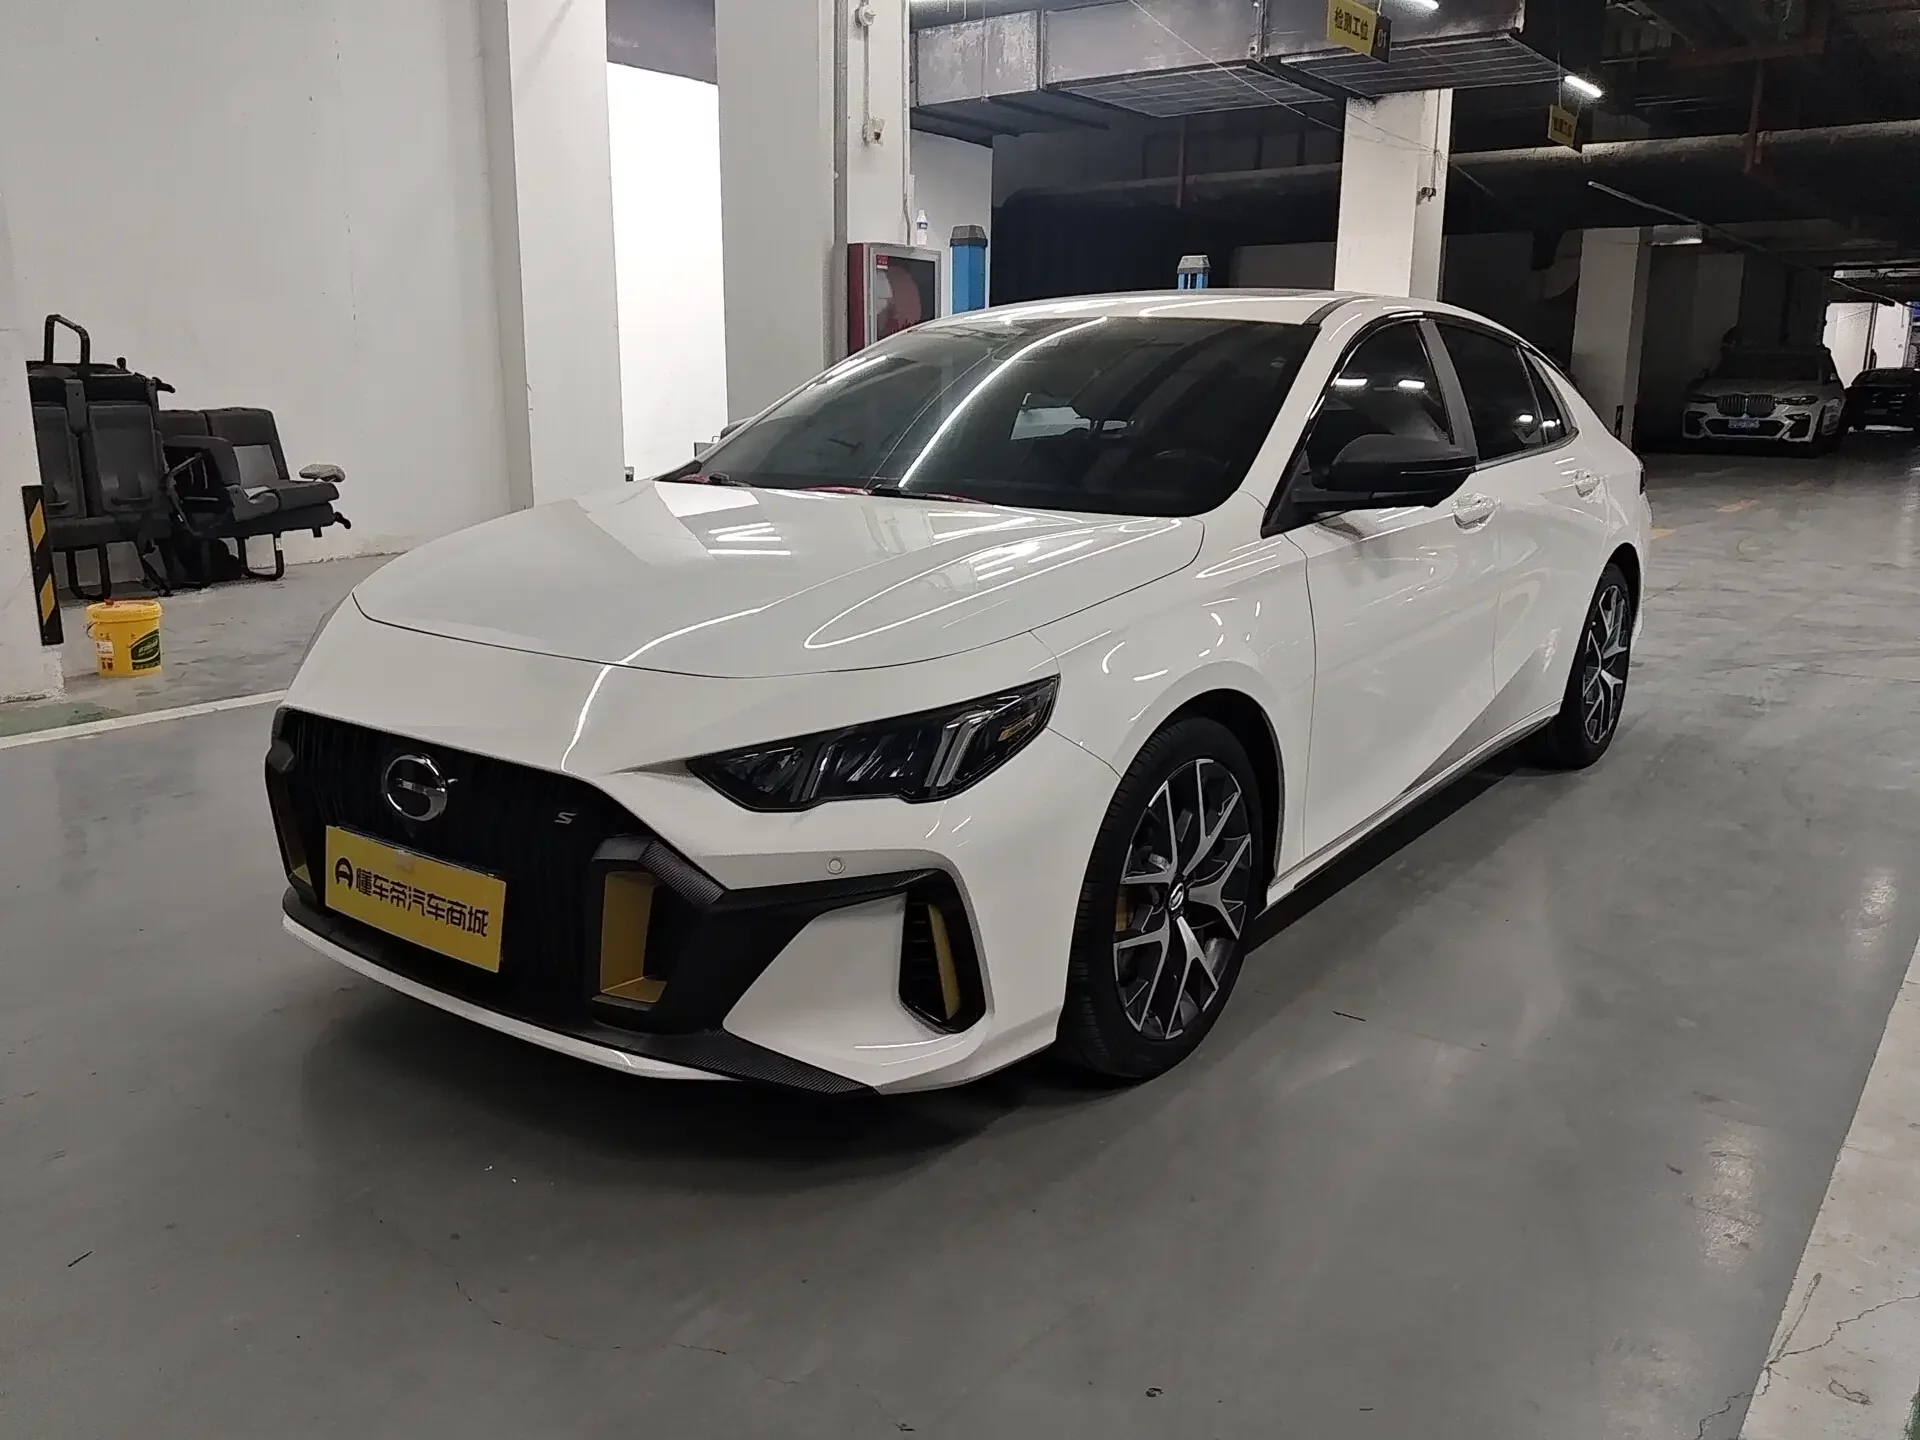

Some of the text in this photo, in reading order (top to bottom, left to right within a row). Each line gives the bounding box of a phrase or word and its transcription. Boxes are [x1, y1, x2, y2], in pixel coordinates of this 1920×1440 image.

[1335, 6, 1368, 40] 检测工位
[553, 812, 577, 825] S
[356, 867, 490, 938] 懂车帝汽车商城
